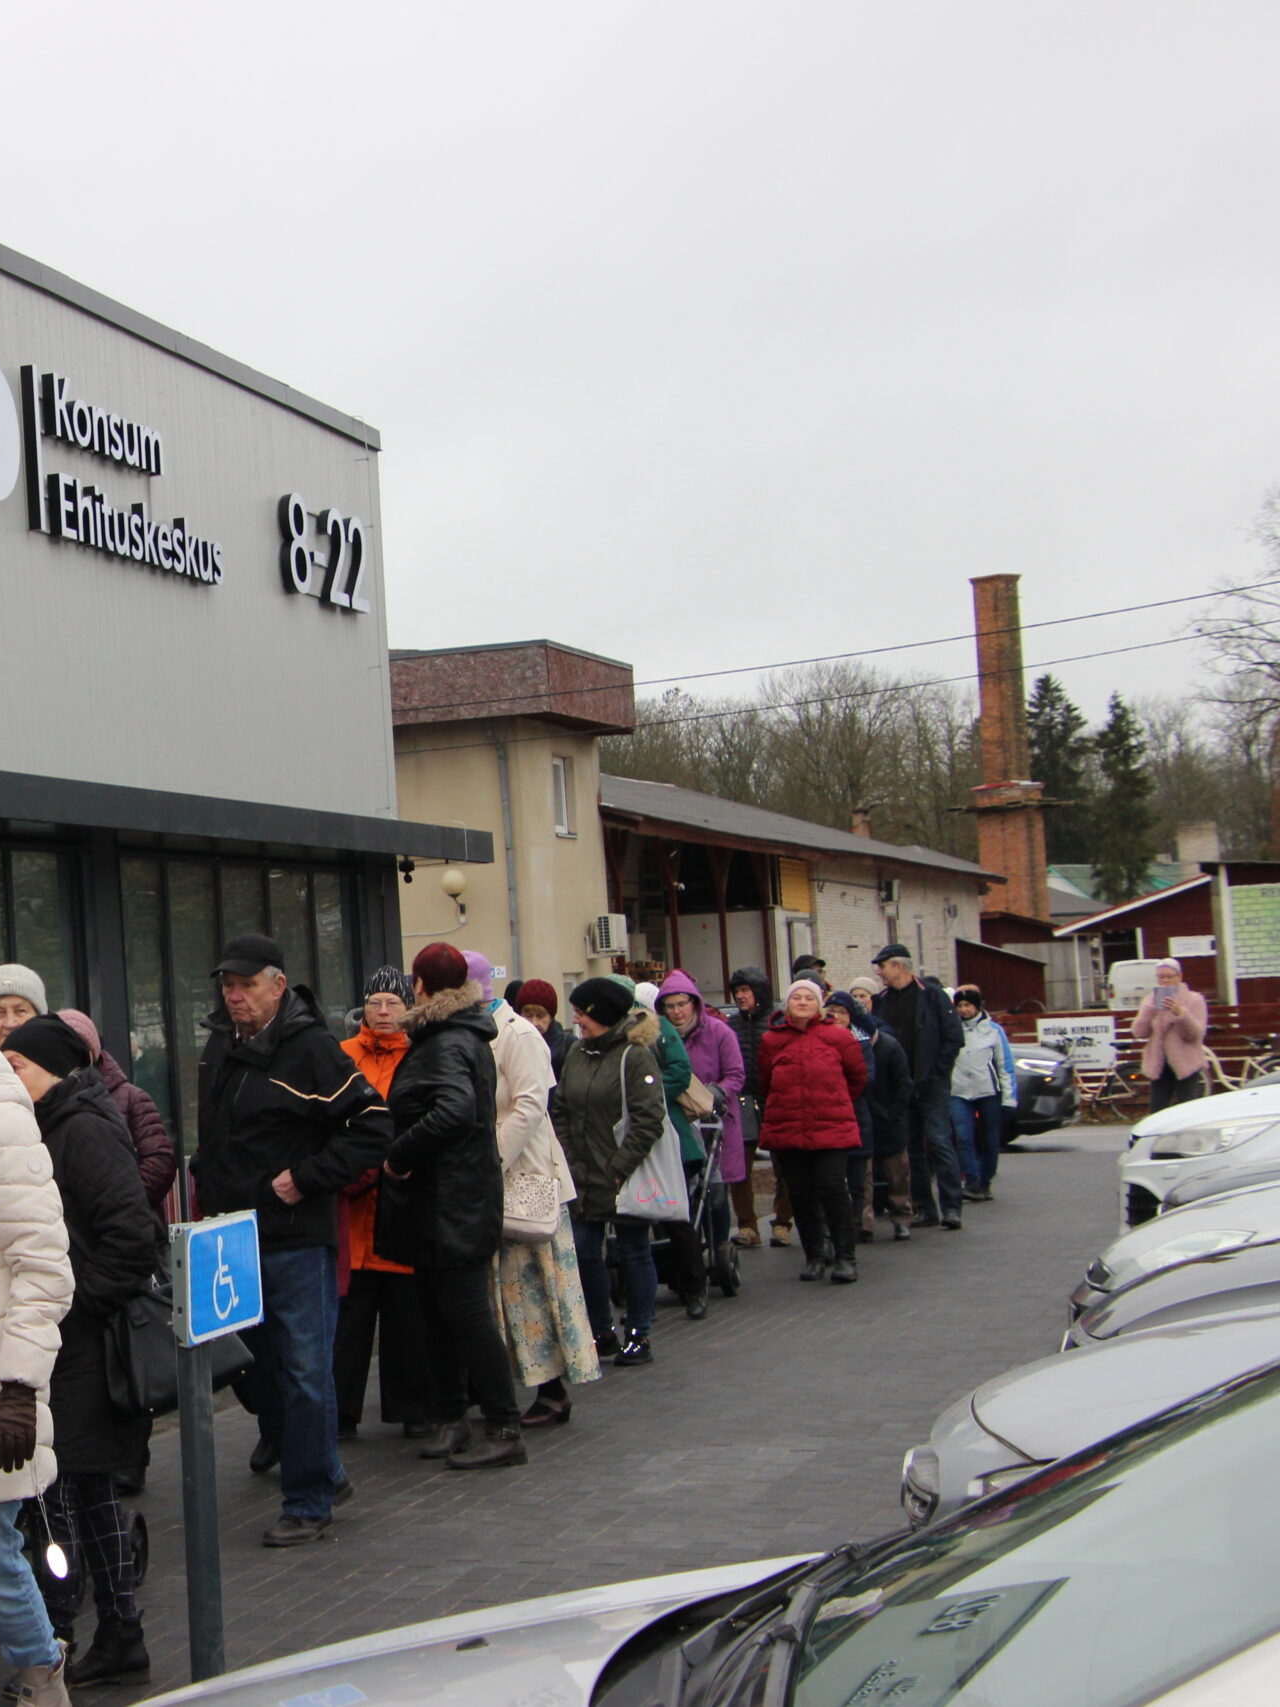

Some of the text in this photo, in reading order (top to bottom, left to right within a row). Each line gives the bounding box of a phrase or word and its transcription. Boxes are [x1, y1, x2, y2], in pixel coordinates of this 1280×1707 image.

[43, 372, 165, 476] Konsum
[49, 472, 223, 585] Ehituskeskus
[279, 492, 370, 613] 8-22
